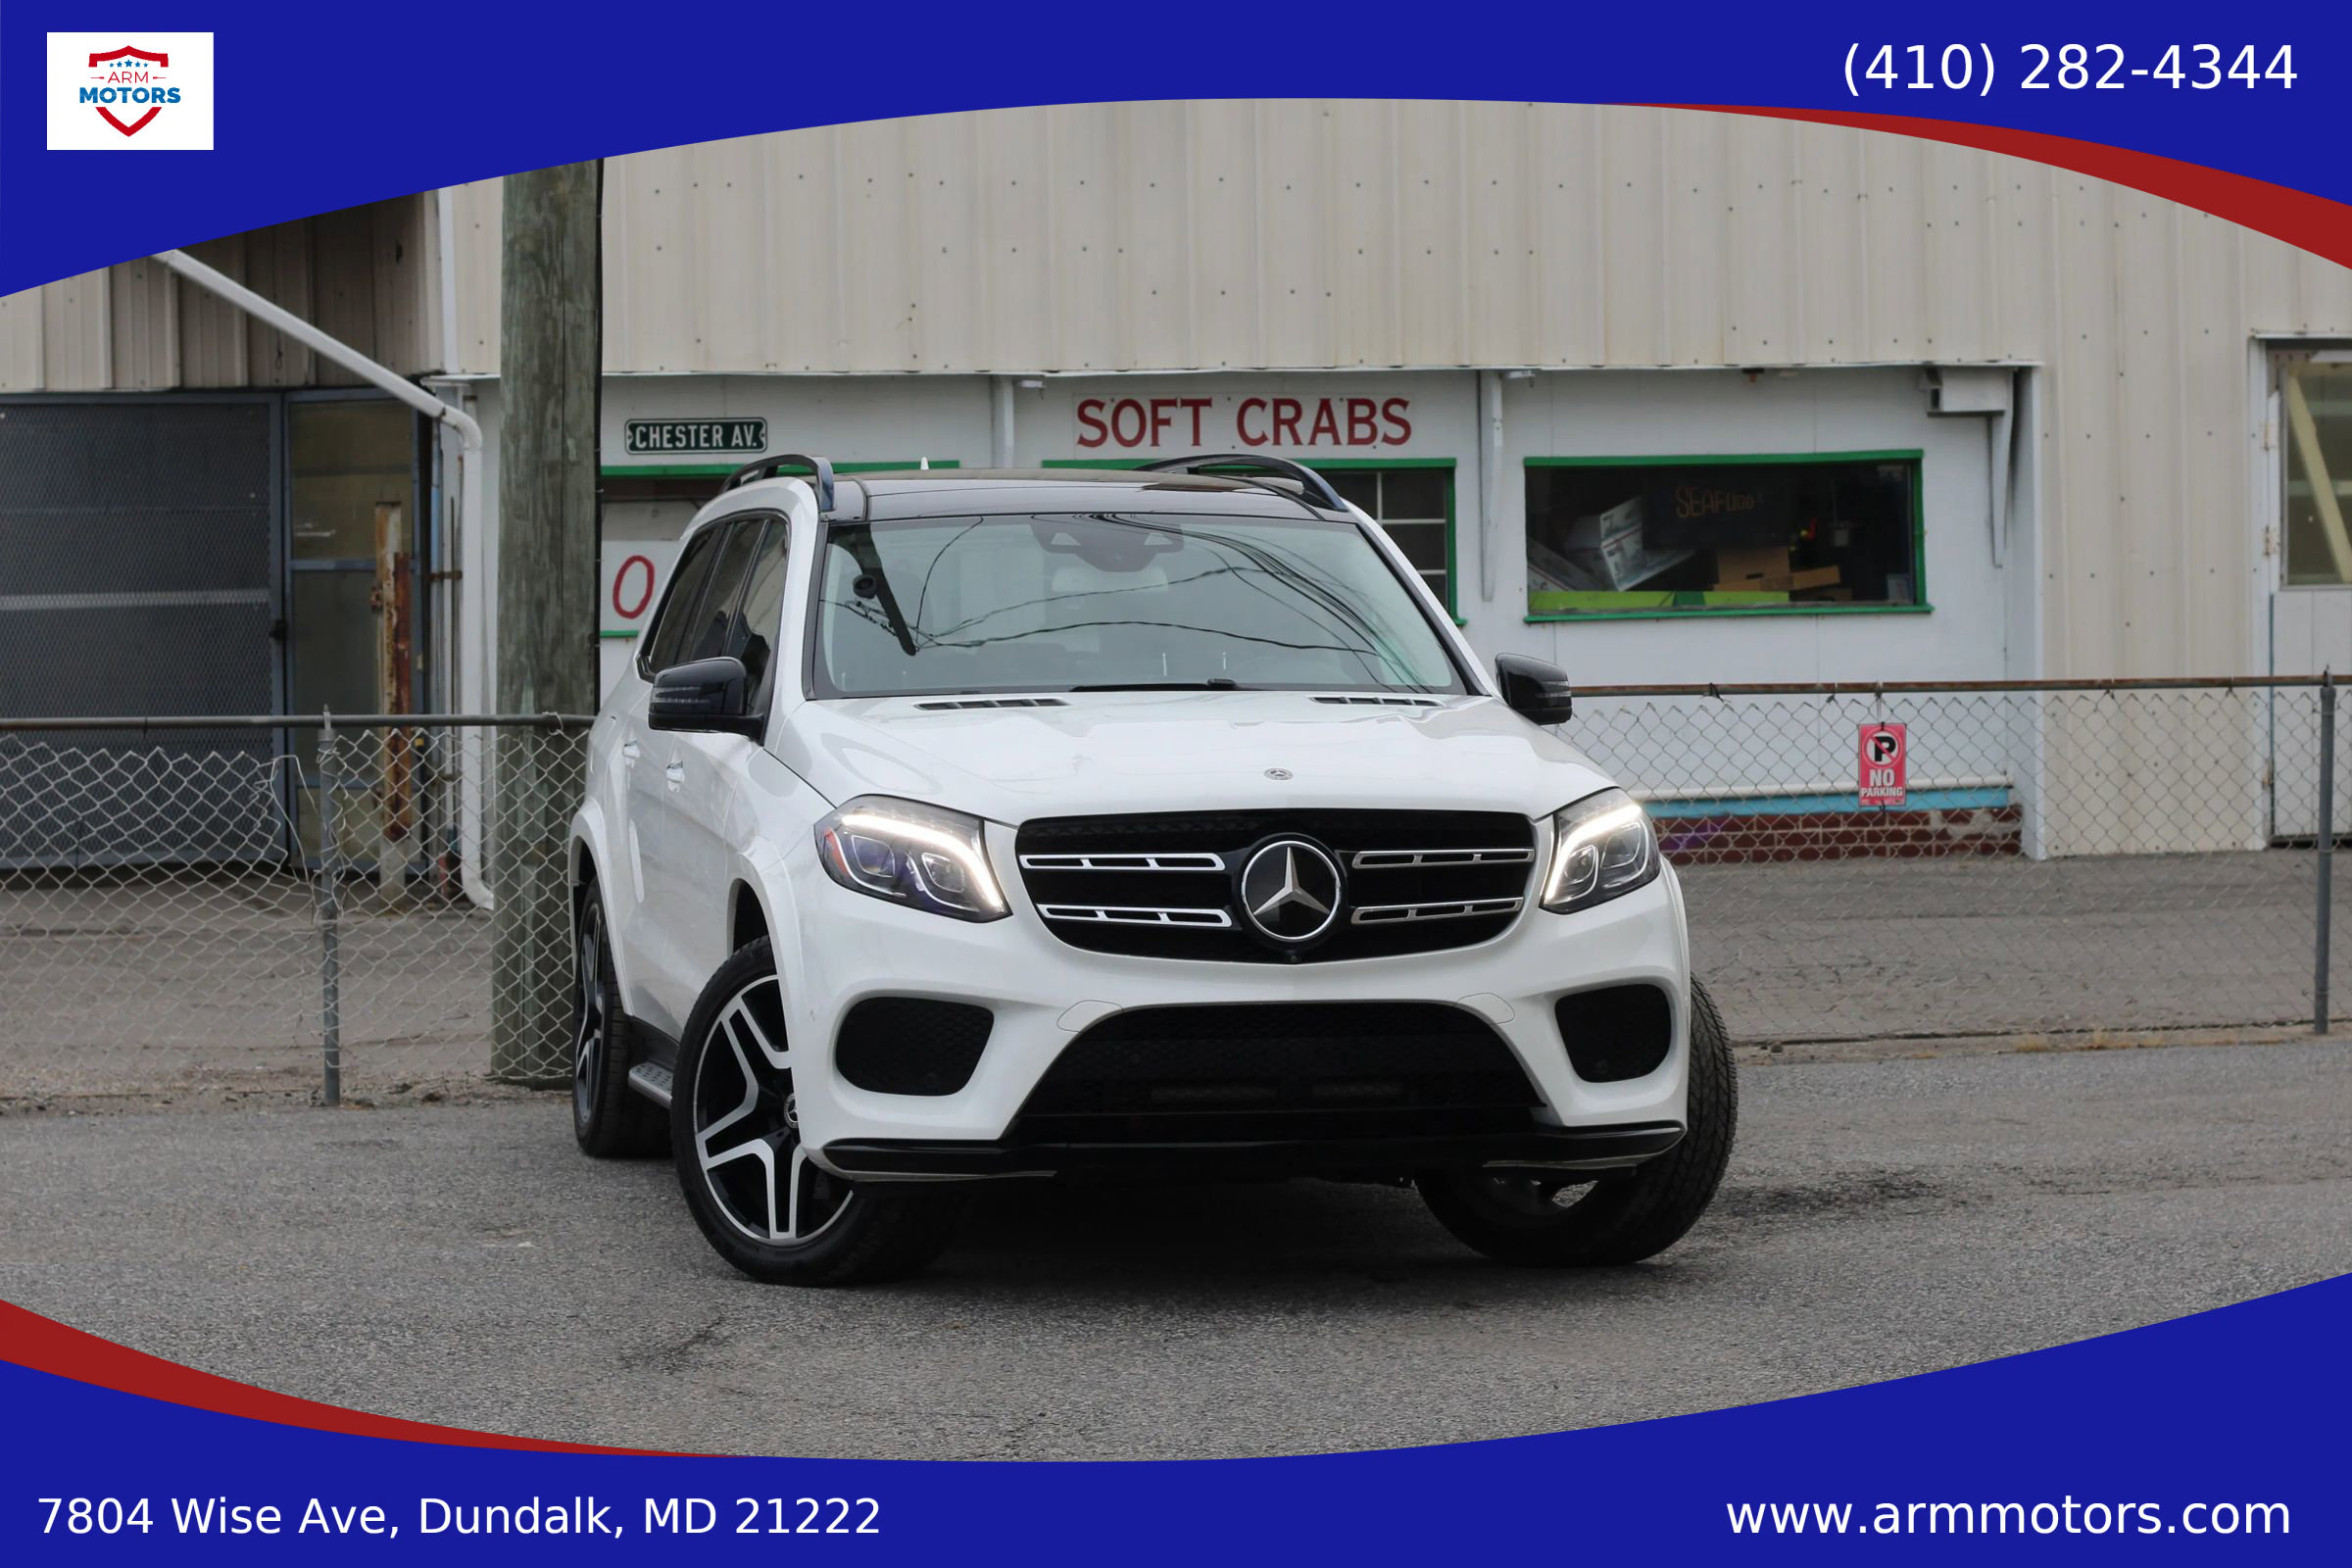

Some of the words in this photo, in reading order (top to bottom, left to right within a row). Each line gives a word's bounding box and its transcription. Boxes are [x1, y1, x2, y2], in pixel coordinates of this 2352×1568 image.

[1076, 397, 1212, 448] SOFT
[1236, 397, 1412, 447] CRABS
[635, 424, 724, 449] CHESTER
[730, 423, 758, 447] AV.
[1869, 768, 1896, 787] NO
[1860, 786, 1903, 798] PARKING
